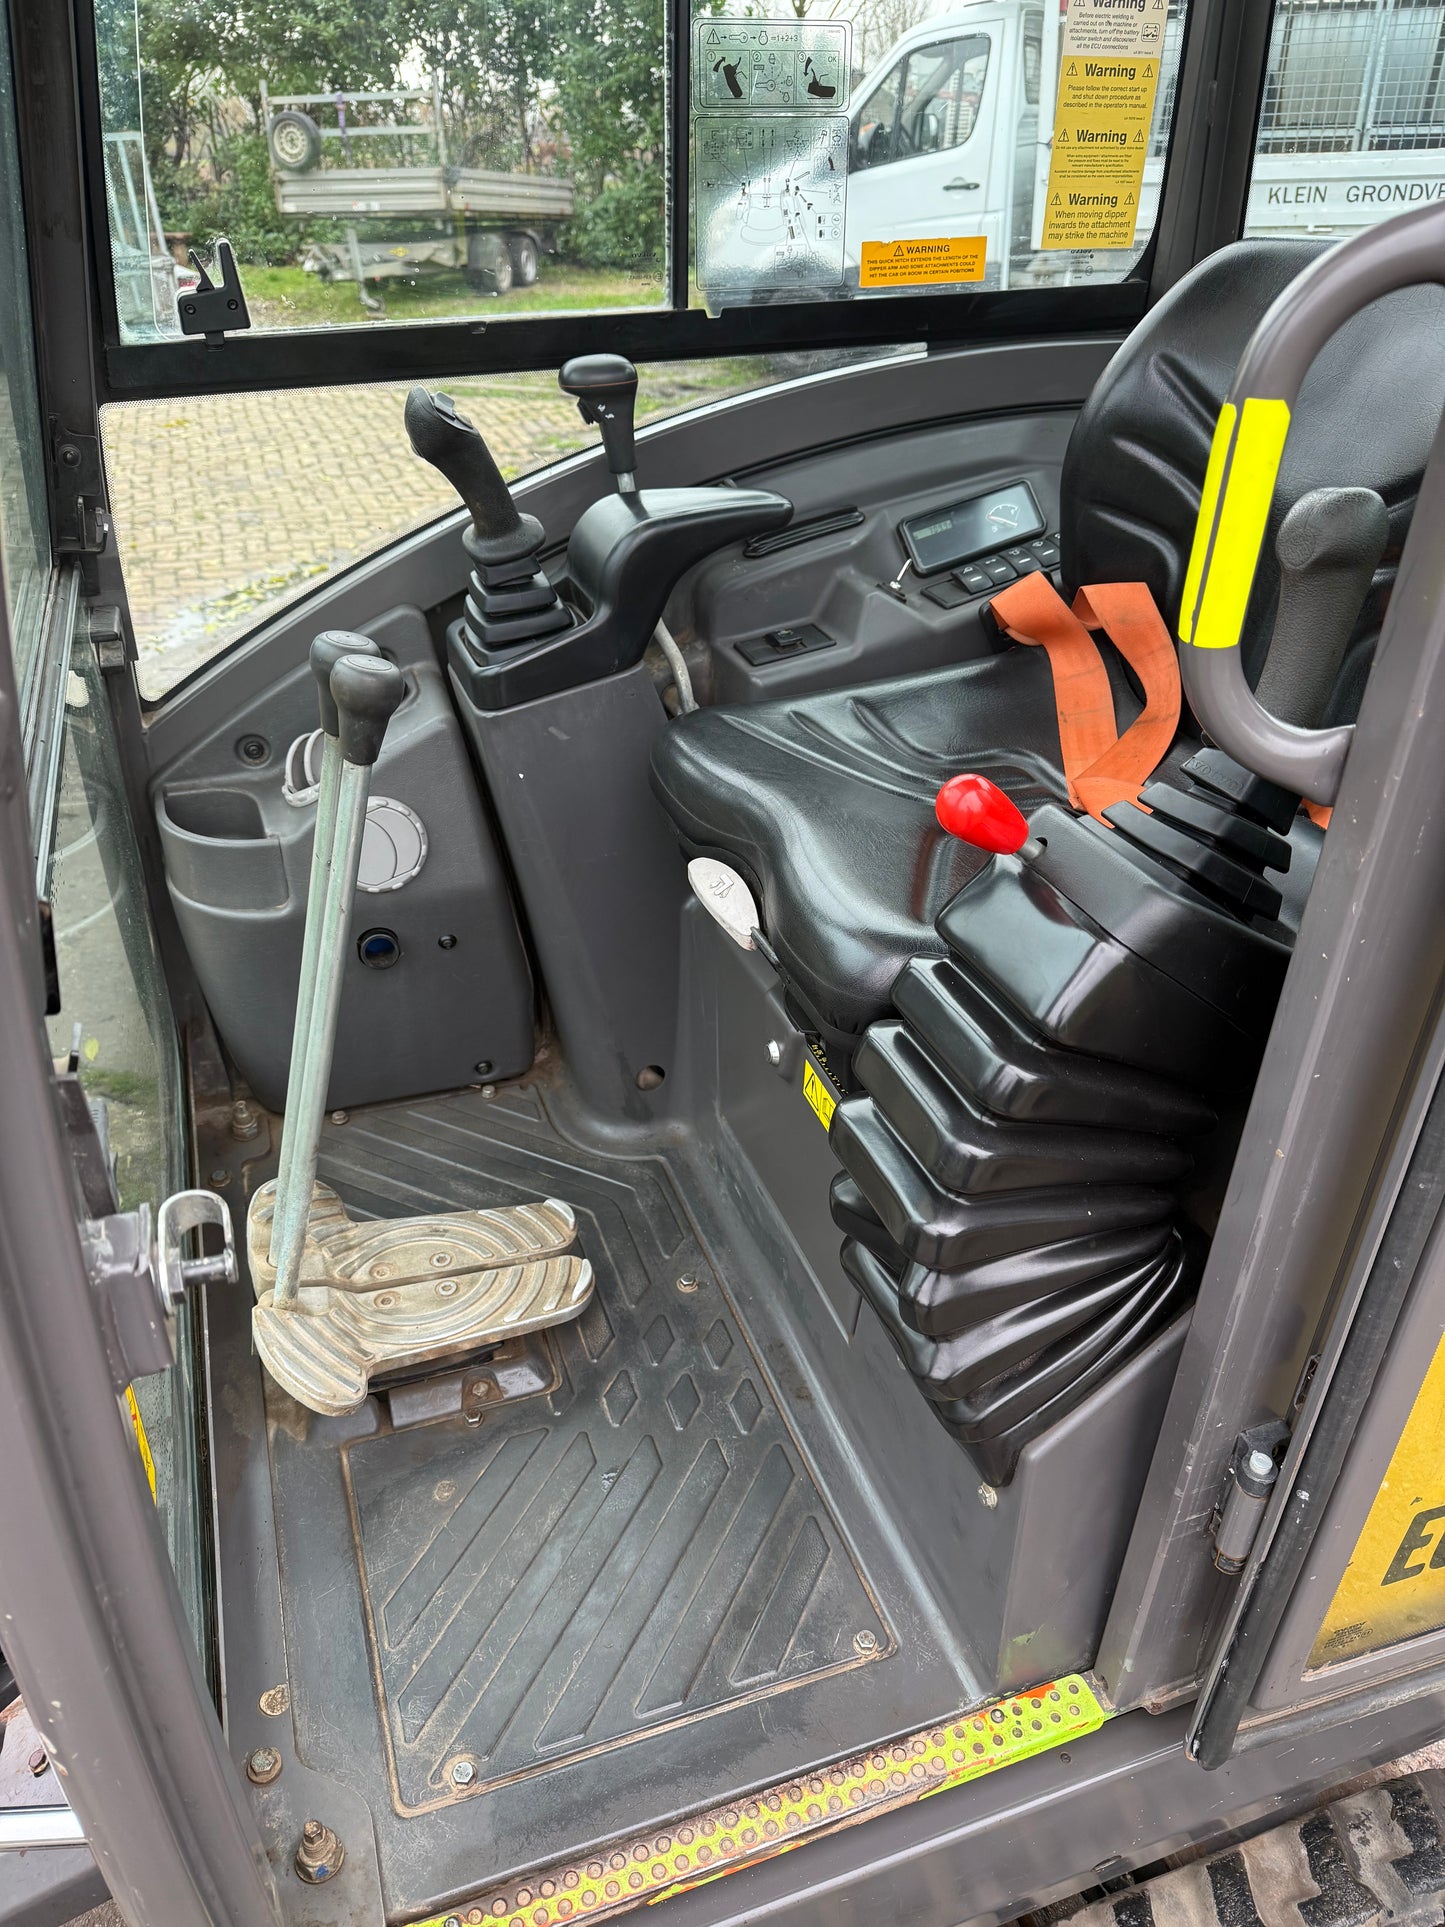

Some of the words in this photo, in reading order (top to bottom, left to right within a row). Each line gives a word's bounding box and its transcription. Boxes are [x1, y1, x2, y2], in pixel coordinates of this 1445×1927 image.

[1093, 0, 1146, 12] Warning
[1085, 63, 1136, 80] Warning
[1077, 130, 1127, 145] Warning
[1068, 193, 1118, 208] Warning
[1268, 185, 1328, 204] KLEIN
[1055, 210, 1076, 218] When
[1077, 210, 1103, 220] moving
[1105, 210, 1128, 219] dipper
[1048, 220, 1076, 229] inwards
[1078, 220, 1090, 228] the
[1091, 220, 1130, 228] attachment
[1048, 233, 1063, 241] may
[1099, 230, 1128, 239] machine
[906, 244, 950, 254] WARNING
